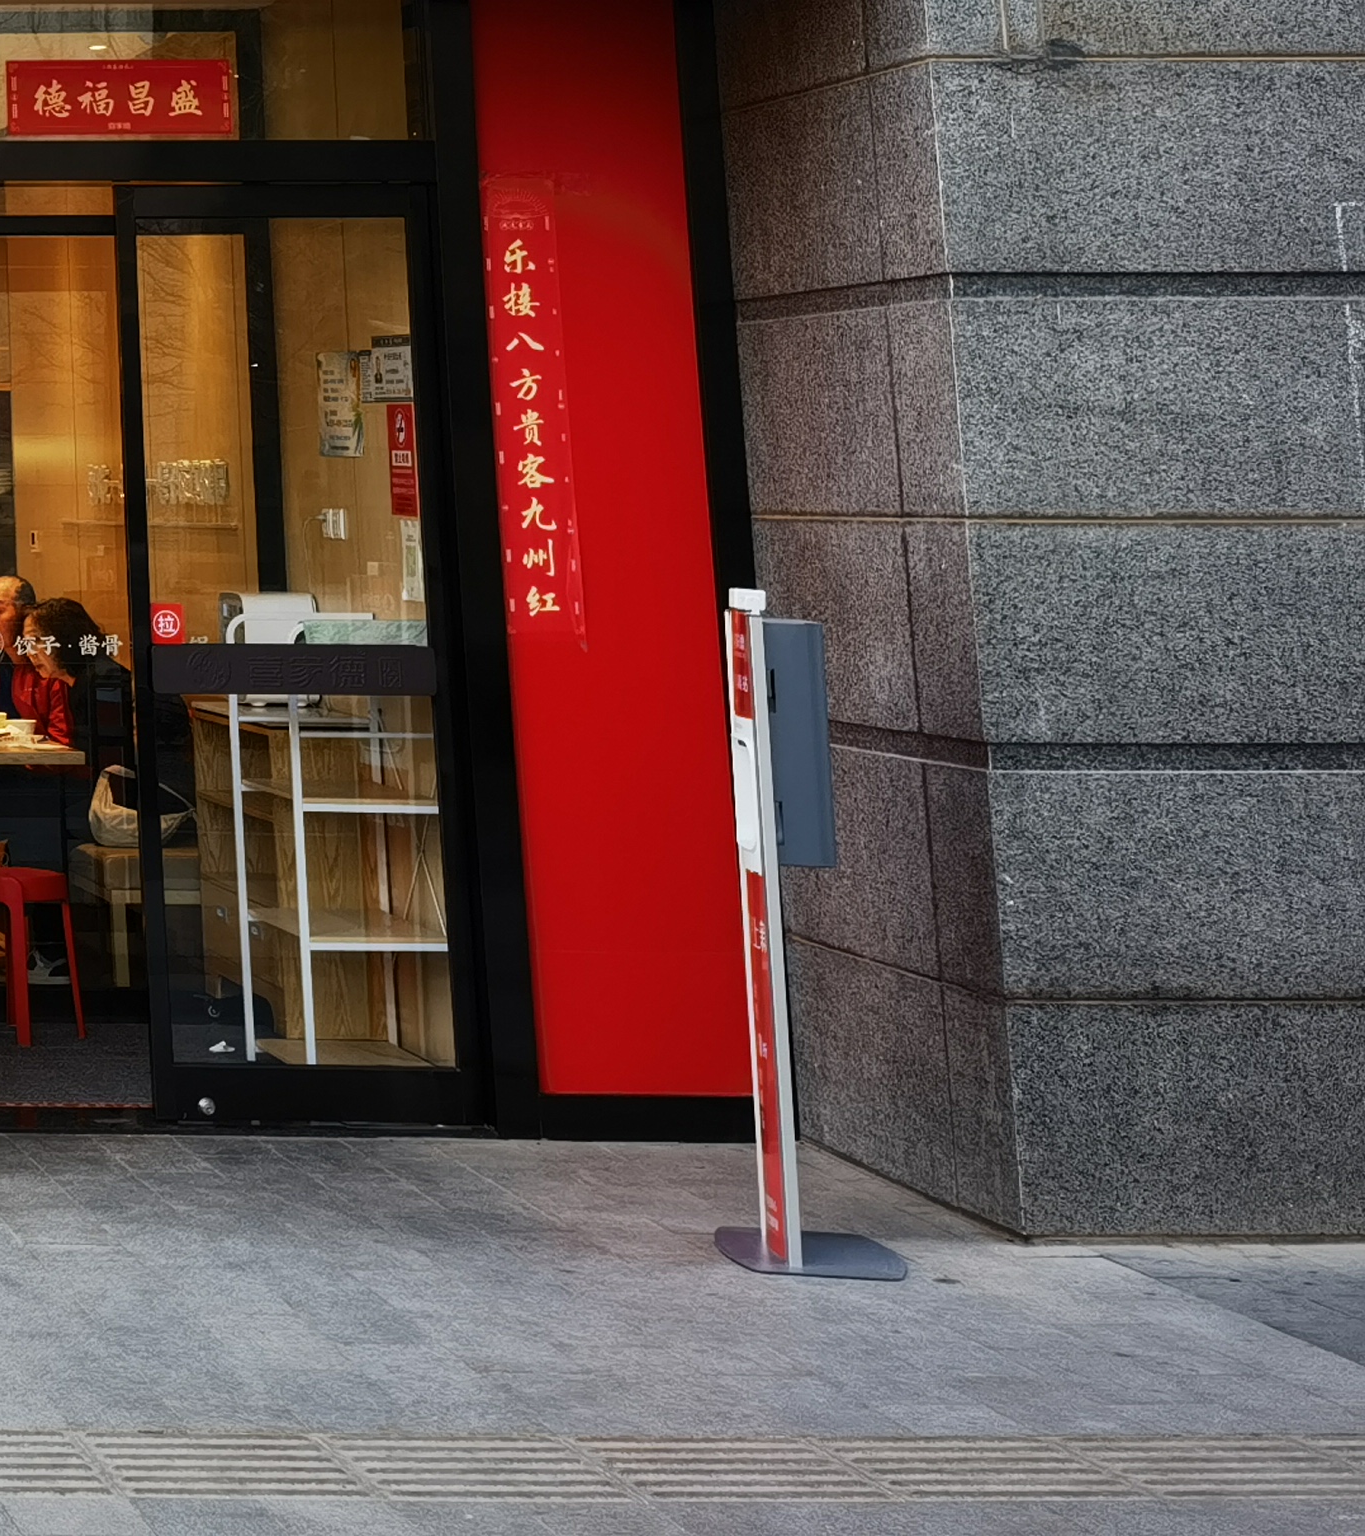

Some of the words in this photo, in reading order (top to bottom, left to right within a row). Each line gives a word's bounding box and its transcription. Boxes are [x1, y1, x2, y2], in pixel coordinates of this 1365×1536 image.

[34, 79, 203, 118] 德福昌盛
[157, 614, 176, 633] 拉
